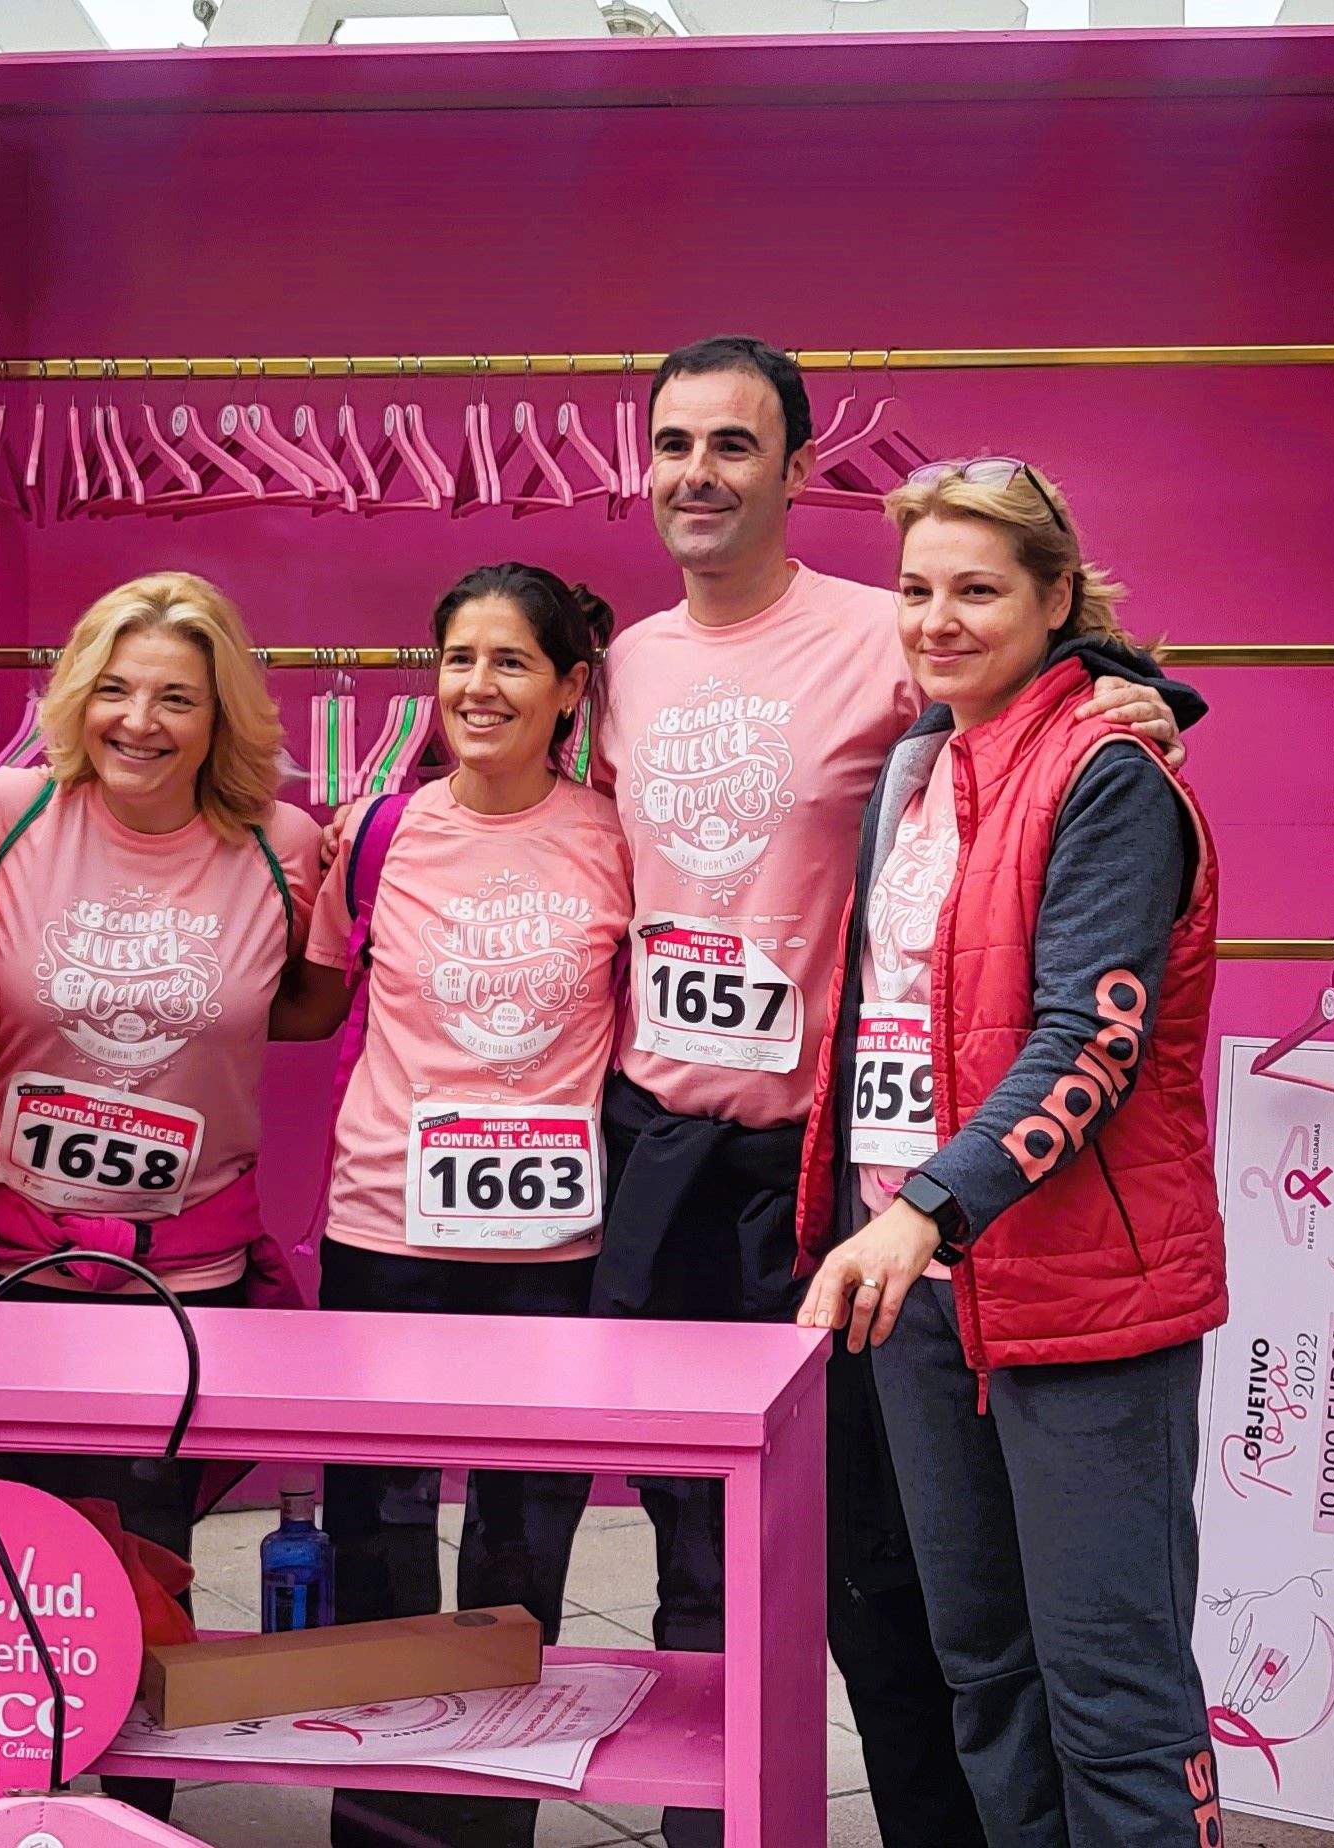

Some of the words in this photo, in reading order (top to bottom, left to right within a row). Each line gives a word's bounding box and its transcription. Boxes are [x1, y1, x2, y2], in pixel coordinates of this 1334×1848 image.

[681, 696, 776, 732] CARRERA
[656, 722, 748, 771] HUESCA
[106, 908, 207, 934] CARRERA
[476, 891, 576, 922] CARRERA
[74, 931, 179, 970] HUESCA
[448, 914, 551, 959] HUESCA
[653, 939, 701, 961] CONTRA
[704, 949, 721, 963] EL
[690, 933, 735, 950] HUESCA
[651, 965, 789, 1032] 1657
[870, 1021, 899, 1033] HUESCA
[876, 1035, 887, 1050] EL
[890, 1032, 932, 1053] CÁNC
[856, 1060, 934, 1124] 659
[1001, 968, 1148, 1184] adida
[29, 1100, 96, 1126] CONTRA
[100, 1115, 117, 1130] EL
[121, 1120, 186, 1145] CÁNCER
[87, 1100, 134, 1119] HUESCA
[482, 1120, 530, 1133] HUESCA
[23, 1123, 180, 1190] 1658
[430, 1133, 495, 1148] CONTRA
[499, 1134, 517, 1148] EL
[520, 1130, 582, 1148] CÁNCER
[1312, 1123, 1321, 1171] SOLIDARIAS
[428, 1156, 585, 1211] 1663
[1307, 1204, 1317, 1250] PERCHAS
[1292, 1333, 1318, 1400] 2022
[1243, 1337, 1270, 1461] OBJETIVO
[1221, 1346, 1308, 1499] Rosa
[2, 1742, 53, 1760] Cánce
